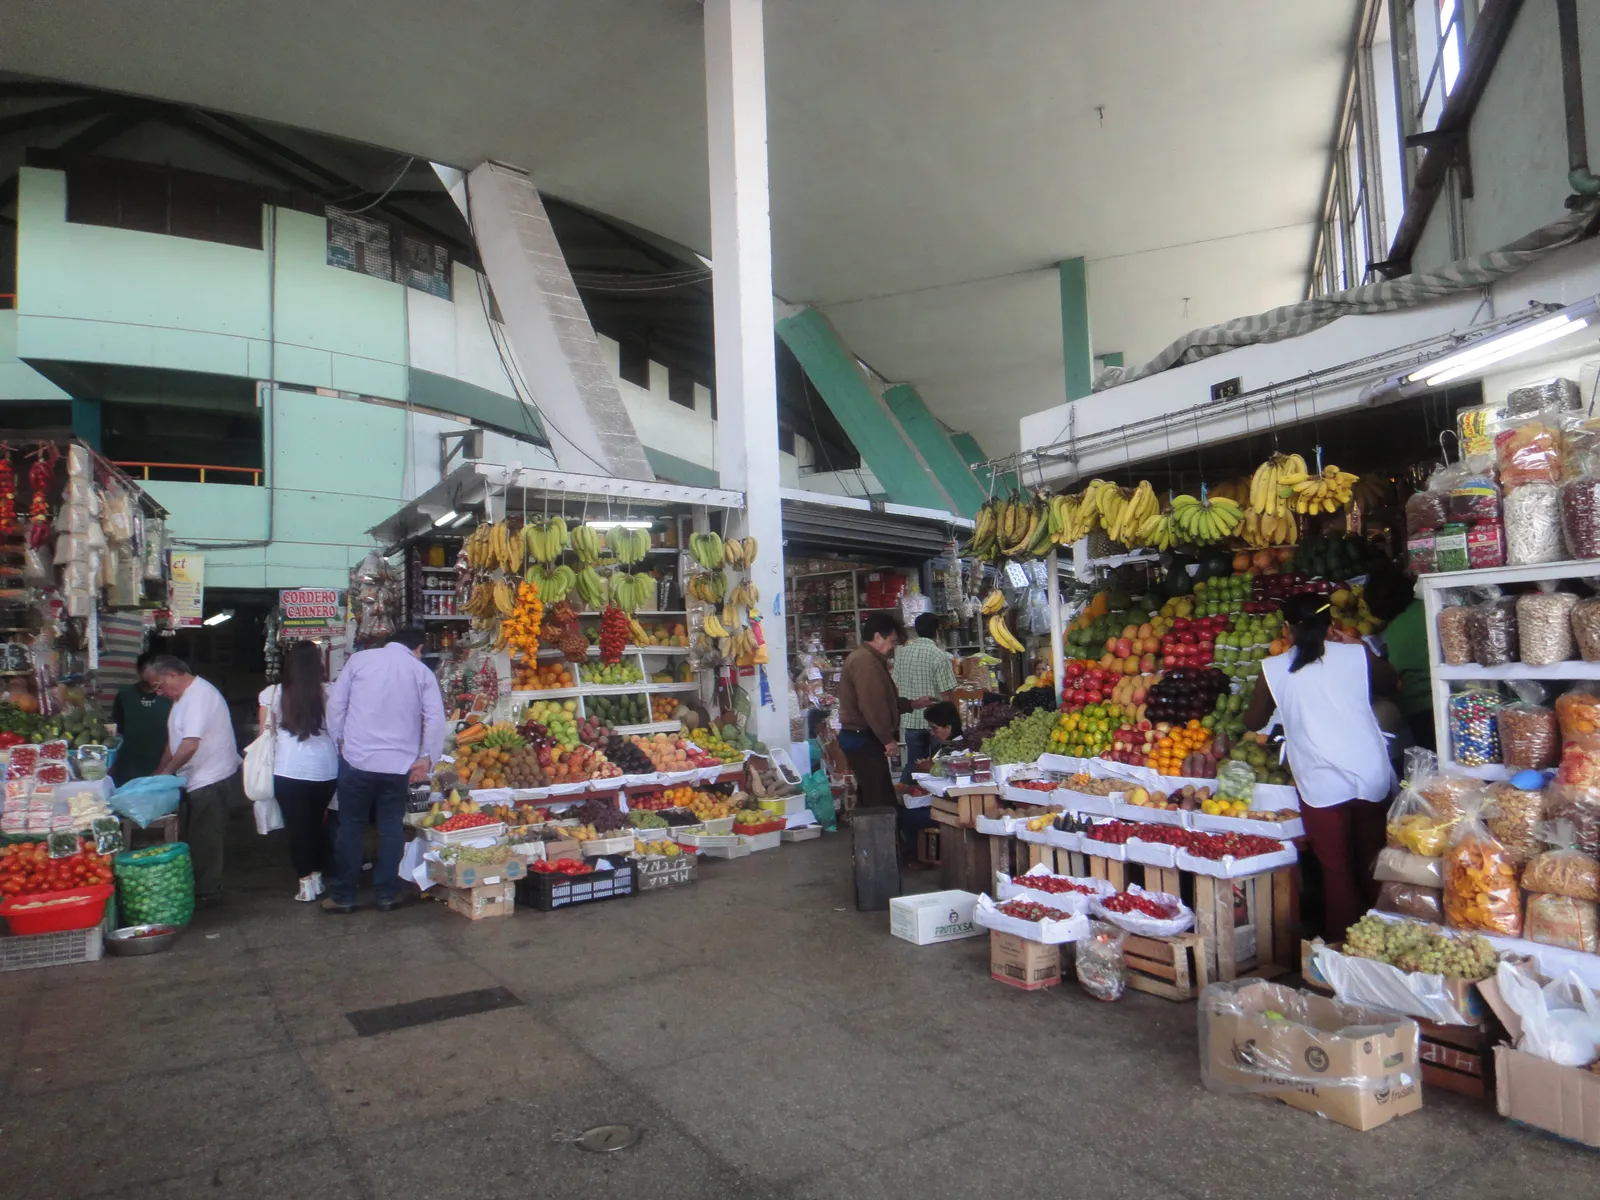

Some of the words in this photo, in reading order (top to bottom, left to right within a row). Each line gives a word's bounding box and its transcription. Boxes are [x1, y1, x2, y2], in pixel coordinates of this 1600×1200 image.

[282, 591, 337, 604] CORDERO
[286, 606, 337, 618] CARNERO
[649, 869, 689, 886] MARIA
